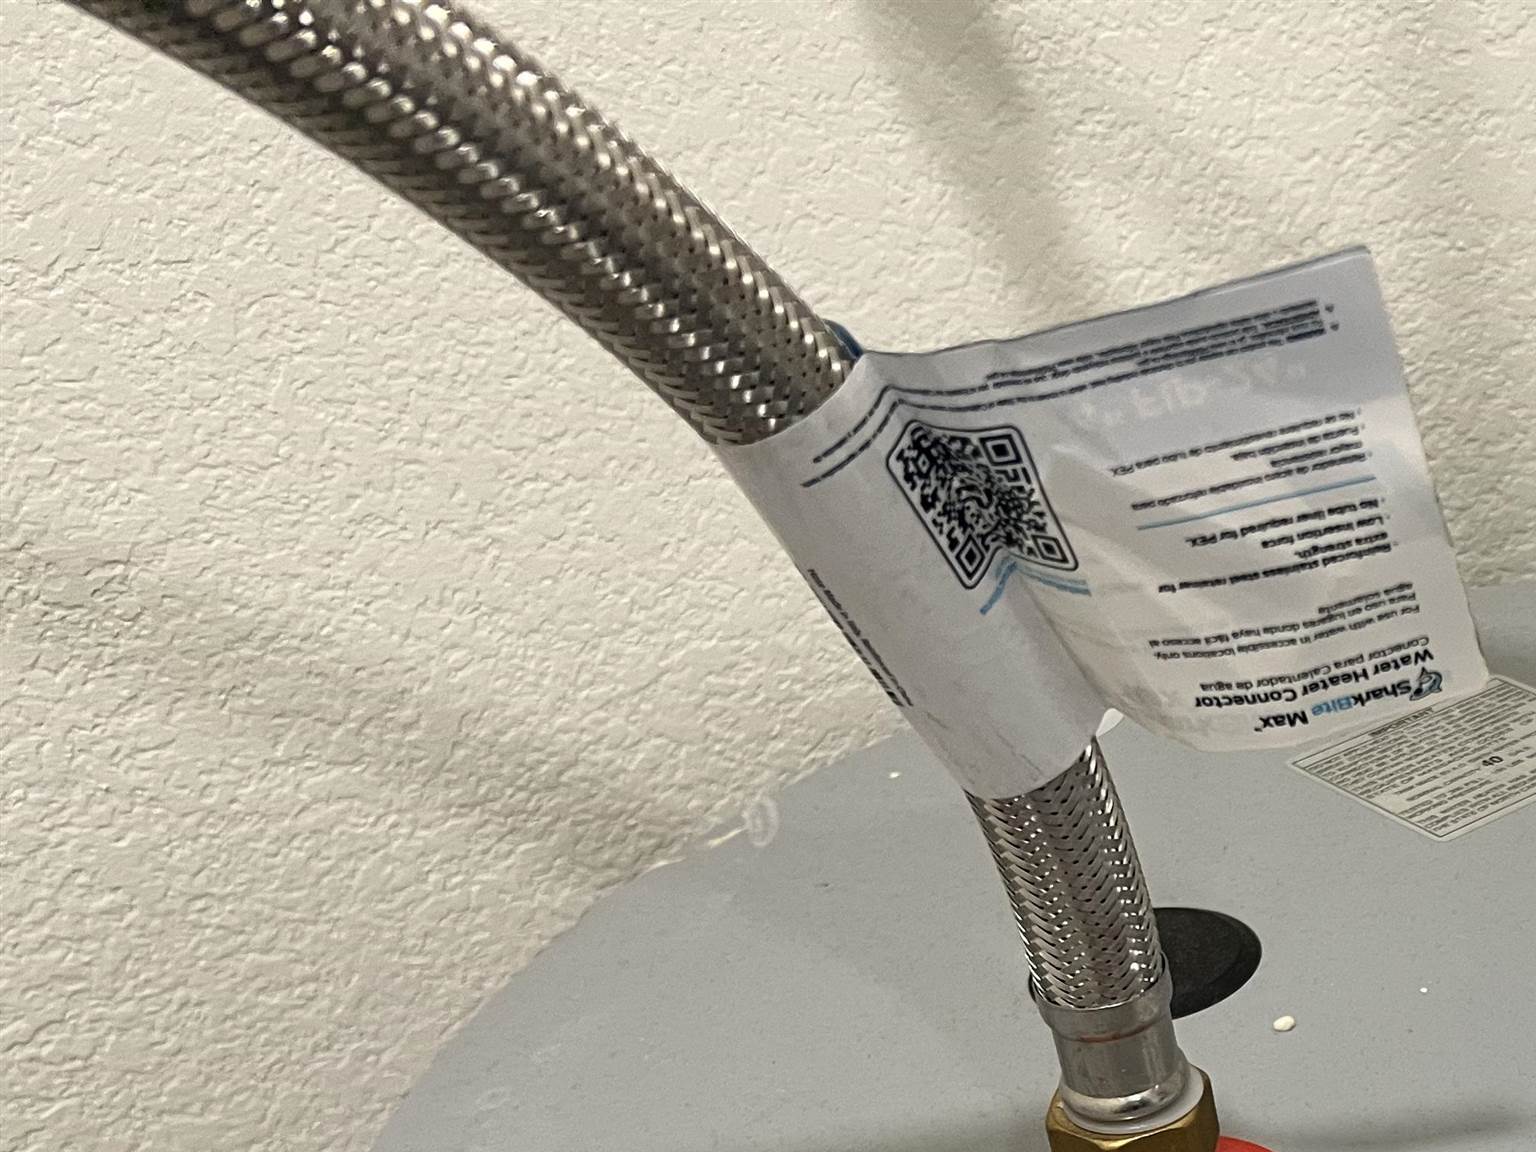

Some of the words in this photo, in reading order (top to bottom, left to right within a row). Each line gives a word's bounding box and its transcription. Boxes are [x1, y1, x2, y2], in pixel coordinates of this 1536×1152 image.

[1368, 635, 1428, 660] Conector
[1333, 653, 1364, 668] para
[1372, 649, 1433, 674] Water
[1199, 680, 1232, 691] agua
[1235, 680, 1253, 690] de
[1256, 664, 1330, 687] Calentador
[1301, 667, 1368, 695] Heater
[1195, 687, 1297, 707] Connector
[1311, 679, 1412, 715] SharkBite
[1482, 756, 1503, 766] 40
